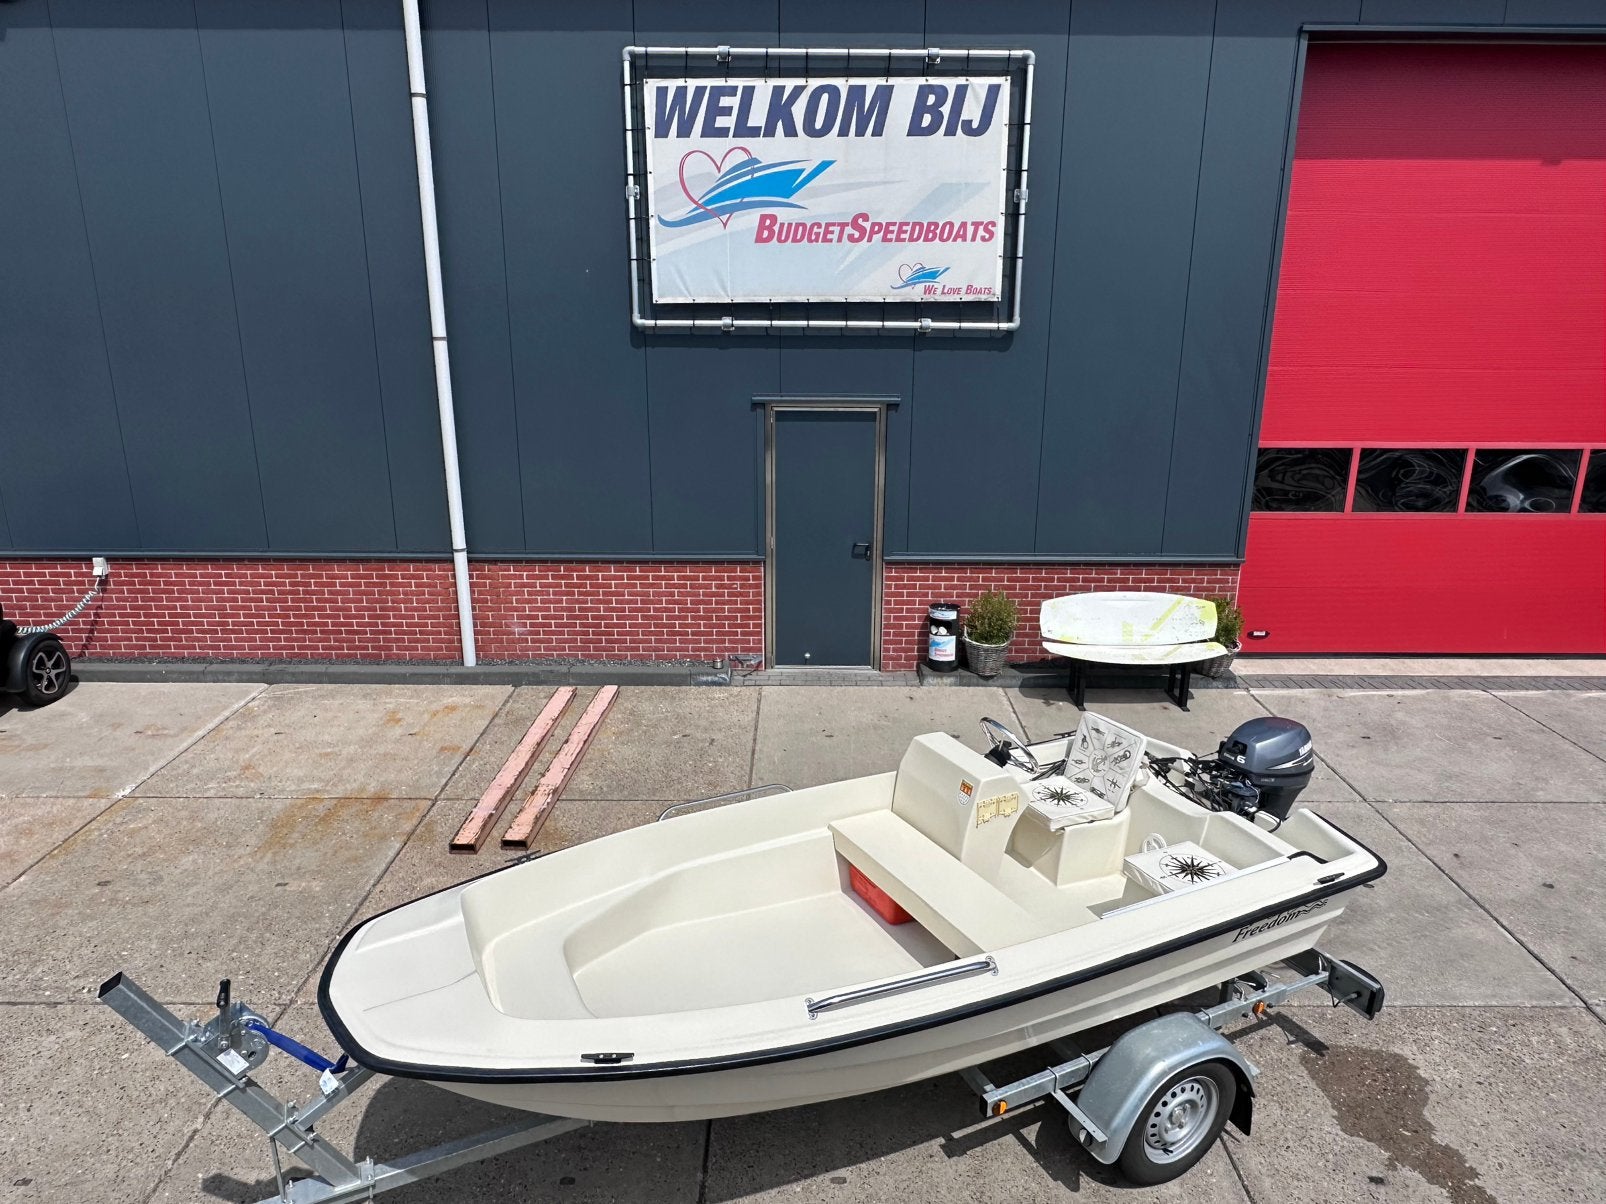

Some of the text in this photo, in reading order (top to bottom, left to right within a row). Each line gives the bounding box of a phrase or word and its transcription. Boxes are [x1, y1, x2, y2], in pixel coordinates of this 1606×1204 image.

[654, 83, 1002, 138] WELKOM BIJ
[1236, 754, 1247, 764] 6
[1232, 910, 1302, 943] Freedom
